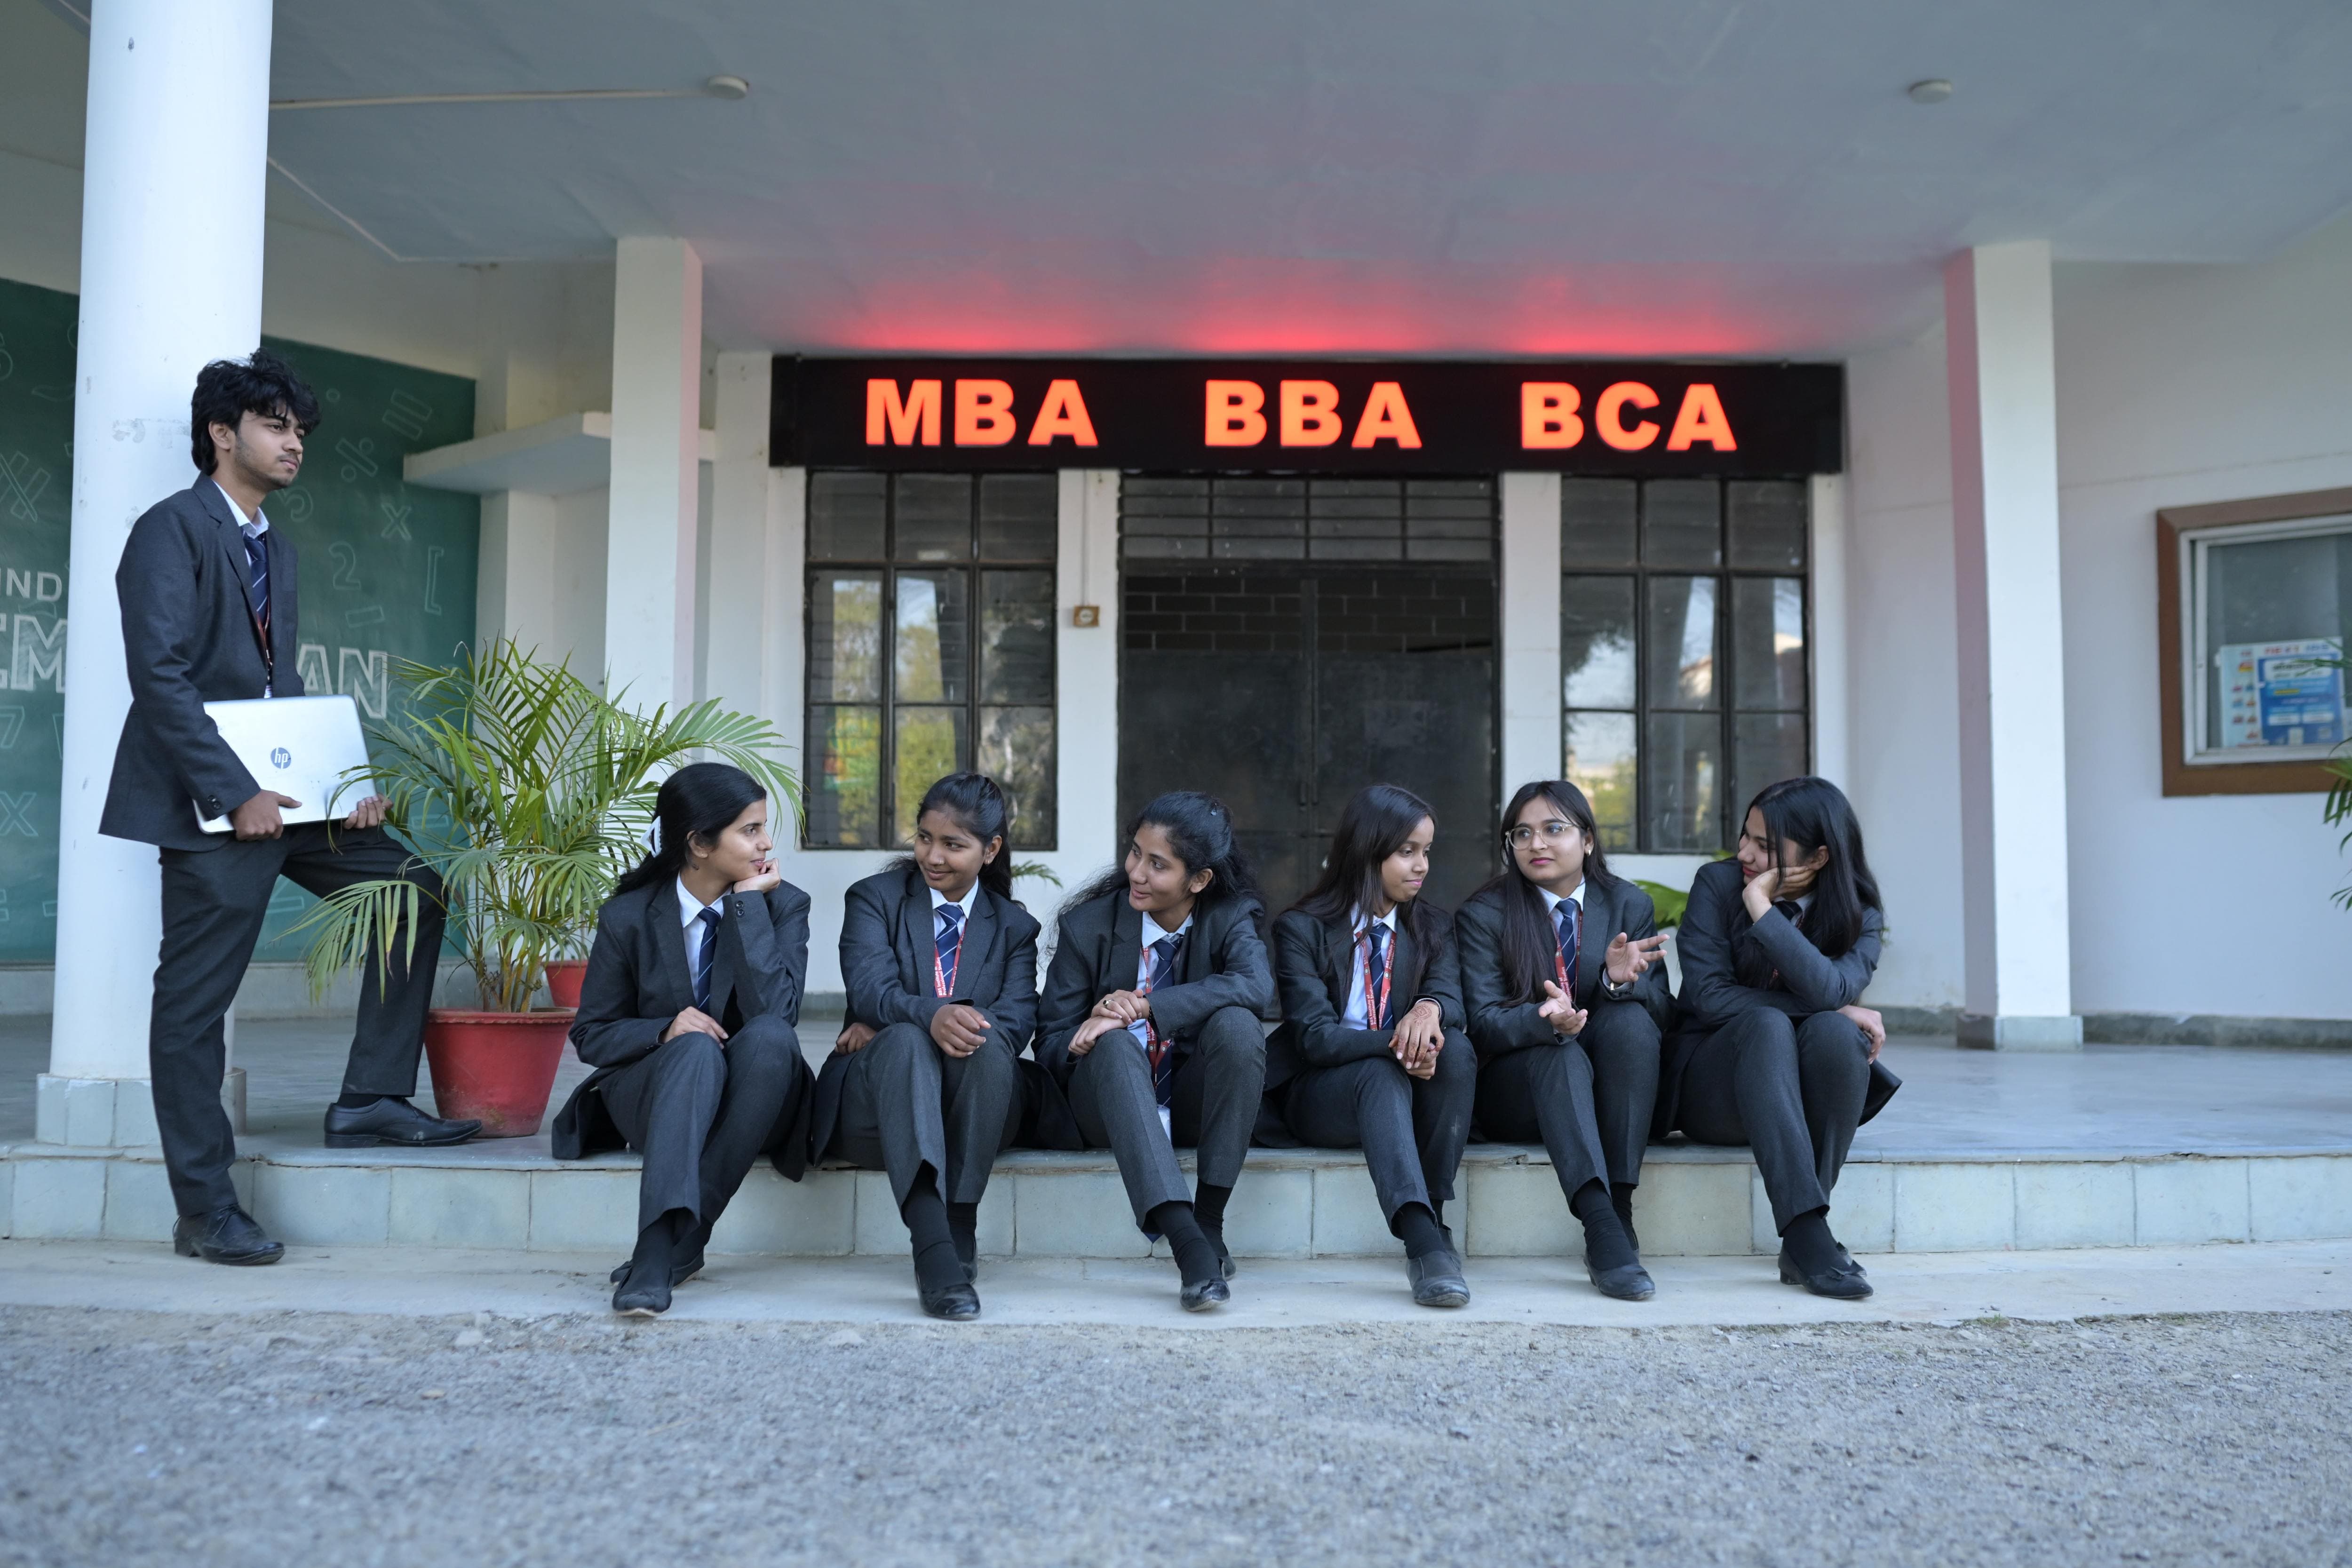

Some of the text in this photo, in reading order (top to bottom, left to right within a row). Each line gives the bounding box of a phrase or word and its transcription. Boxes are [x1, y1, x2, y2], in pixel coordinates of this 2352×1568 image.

[866, 379, 1737, 451] MBA BBA BCA
[0, 613, 68, 694] M
[273, 747, 289, 769] hp
